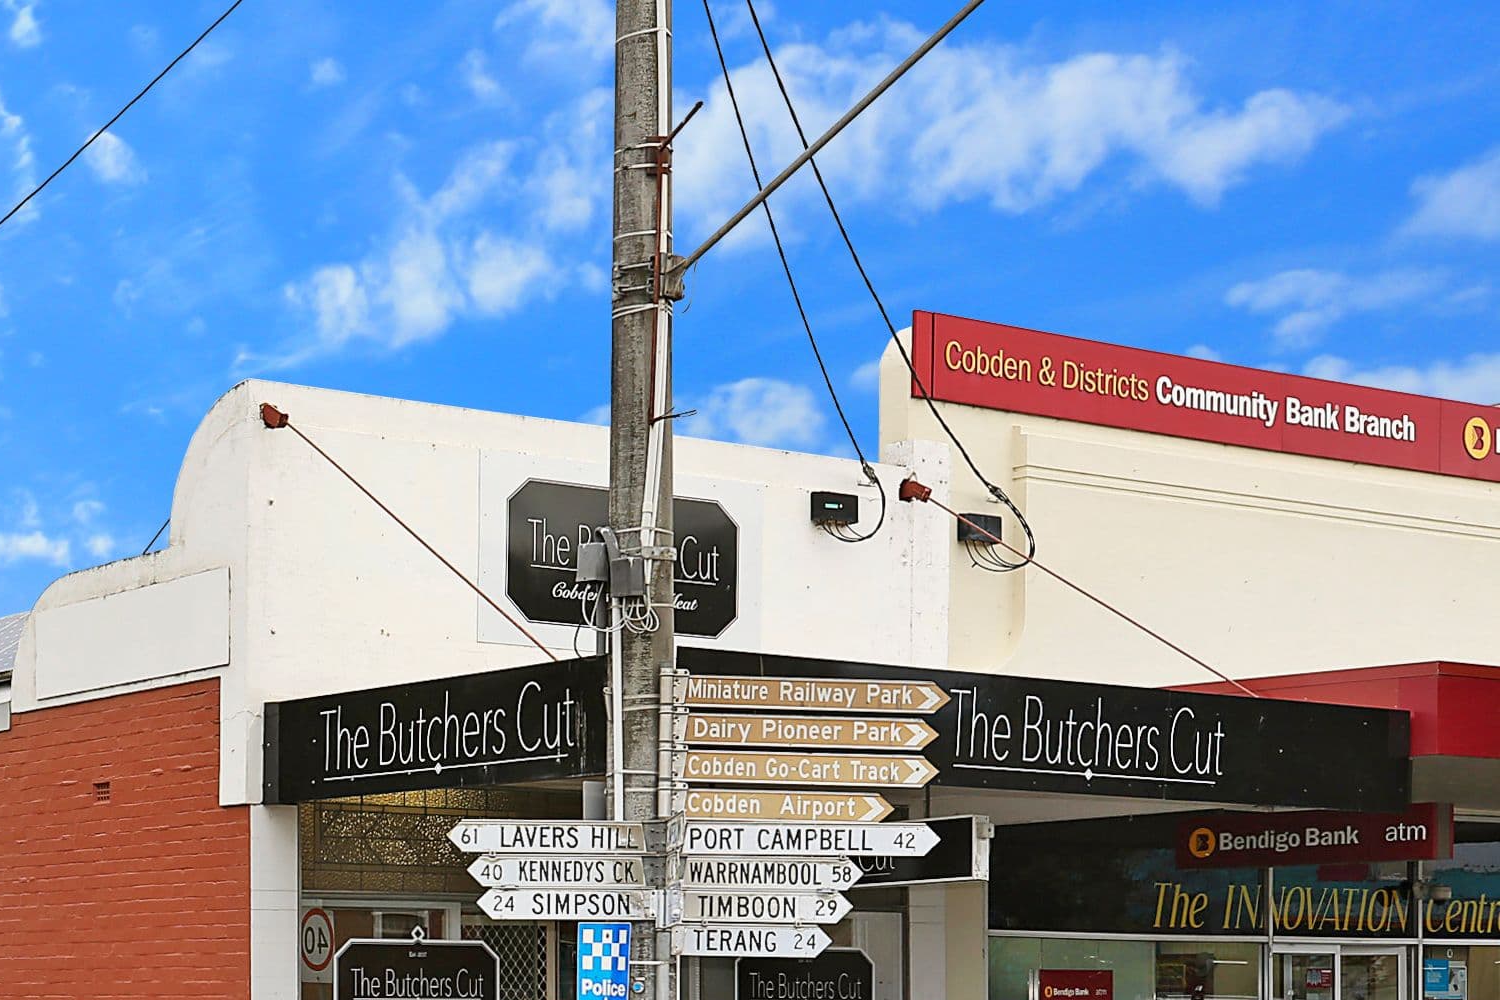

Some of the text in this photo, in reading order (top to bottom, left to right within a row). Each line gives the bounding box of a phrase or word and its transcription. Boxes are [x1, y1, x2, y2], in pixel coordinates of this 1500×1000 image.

[945, 340, 1416, 442] Cobden & Districts Community Bank Branch
[527, 518, 570, 566] The
[680, 535, 719, 581] Cut
[552, 581, 598, 602] Cobde
[688, 678, 913, 708] Miniature Railway Park
[320, 681, 575, 771] The Butchers Cut
[694, 718, 902, 743] Dairy Pioneer Park
[950, 687, 1225, 775] The Butchers Cut
[688, 755, 900, 781] Cobden Go-Cart Track
[688, 792, 856, 820] Cobden Airport
[461, 827, 639, 849] 61 LAVERS HILL
[689, 828, 916, 851] PORT CAMPBELL 42
[1219, 830, 1301, 852] Bendigo
[1305, 825, 1359, 847] Bank
[1385, 822, 1427, 843] atm
[481, 864, 502, 880] 40
[519, 861, 604, 883] KENNEDYS
[689, 862, 852, 886] WARRNAMBOOL 58
[493, 893, 631, 915] 24 SIMPSON
[697, 896, 837, 918] TIMBOON 29
[1153, 881, 1500, 934] The INNOVATION Centr
[693, 929, 817, 952] TERANG 24
[350, 967, 484, 998] The Butchers Cut
[581, 978, 626, 997] Police
[749, 972, 862, 1000] The Butchers Cut
[1053, 987, 1089, 997] Bendigo Bank
